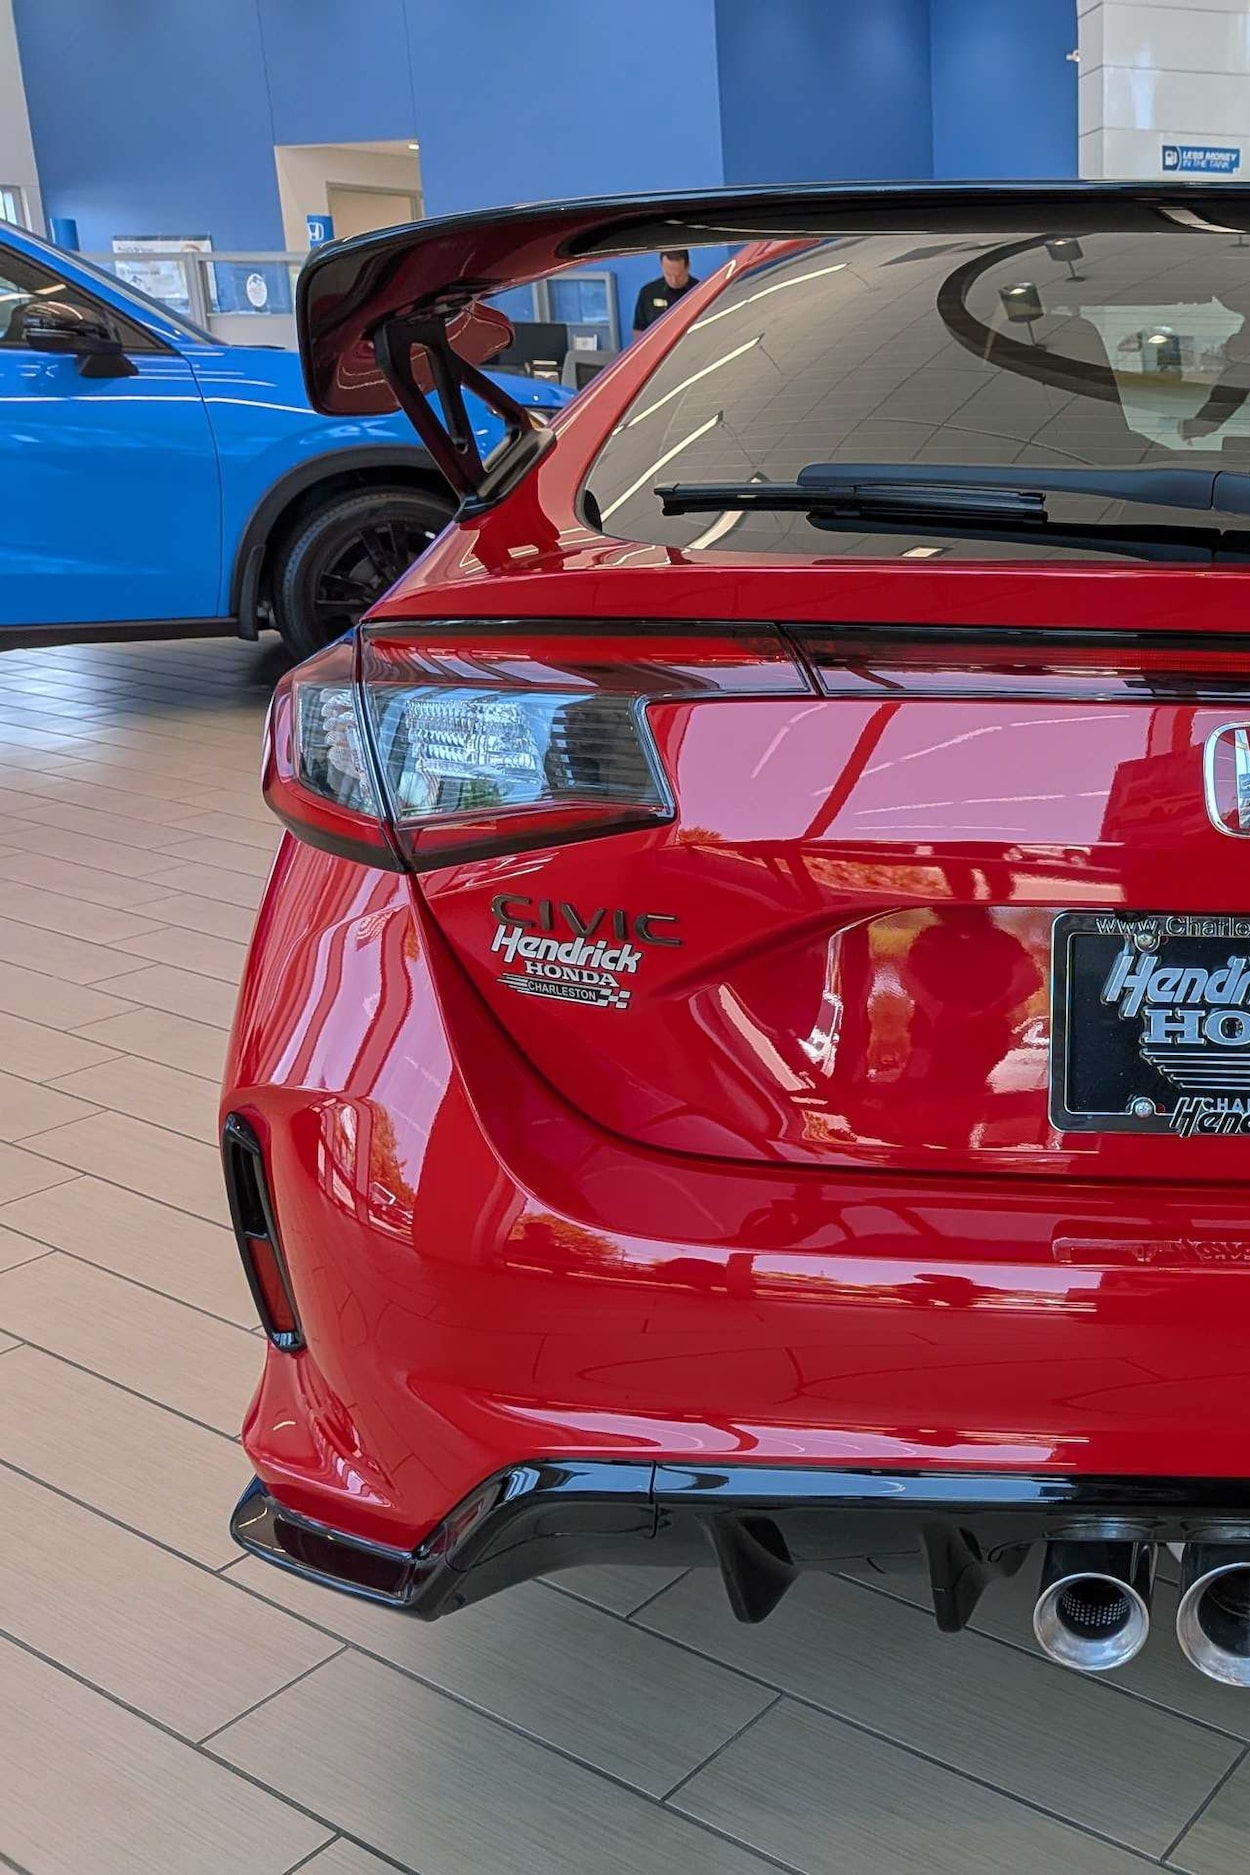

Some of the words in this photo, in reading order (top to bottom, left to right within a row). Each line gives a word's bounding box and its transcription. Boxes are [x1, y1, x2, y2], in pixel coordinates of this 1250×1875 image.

[1183, 151, 1204, 161] LESS
[1205, 152, 1237, 162] MONEY
[491, 893, 683, 948] CIVIC
[491, 924, 643, 974] Hendrick
[524, 960, 621, 988] HONDA
[527, 980, 598, 1001] CHARLESTON
